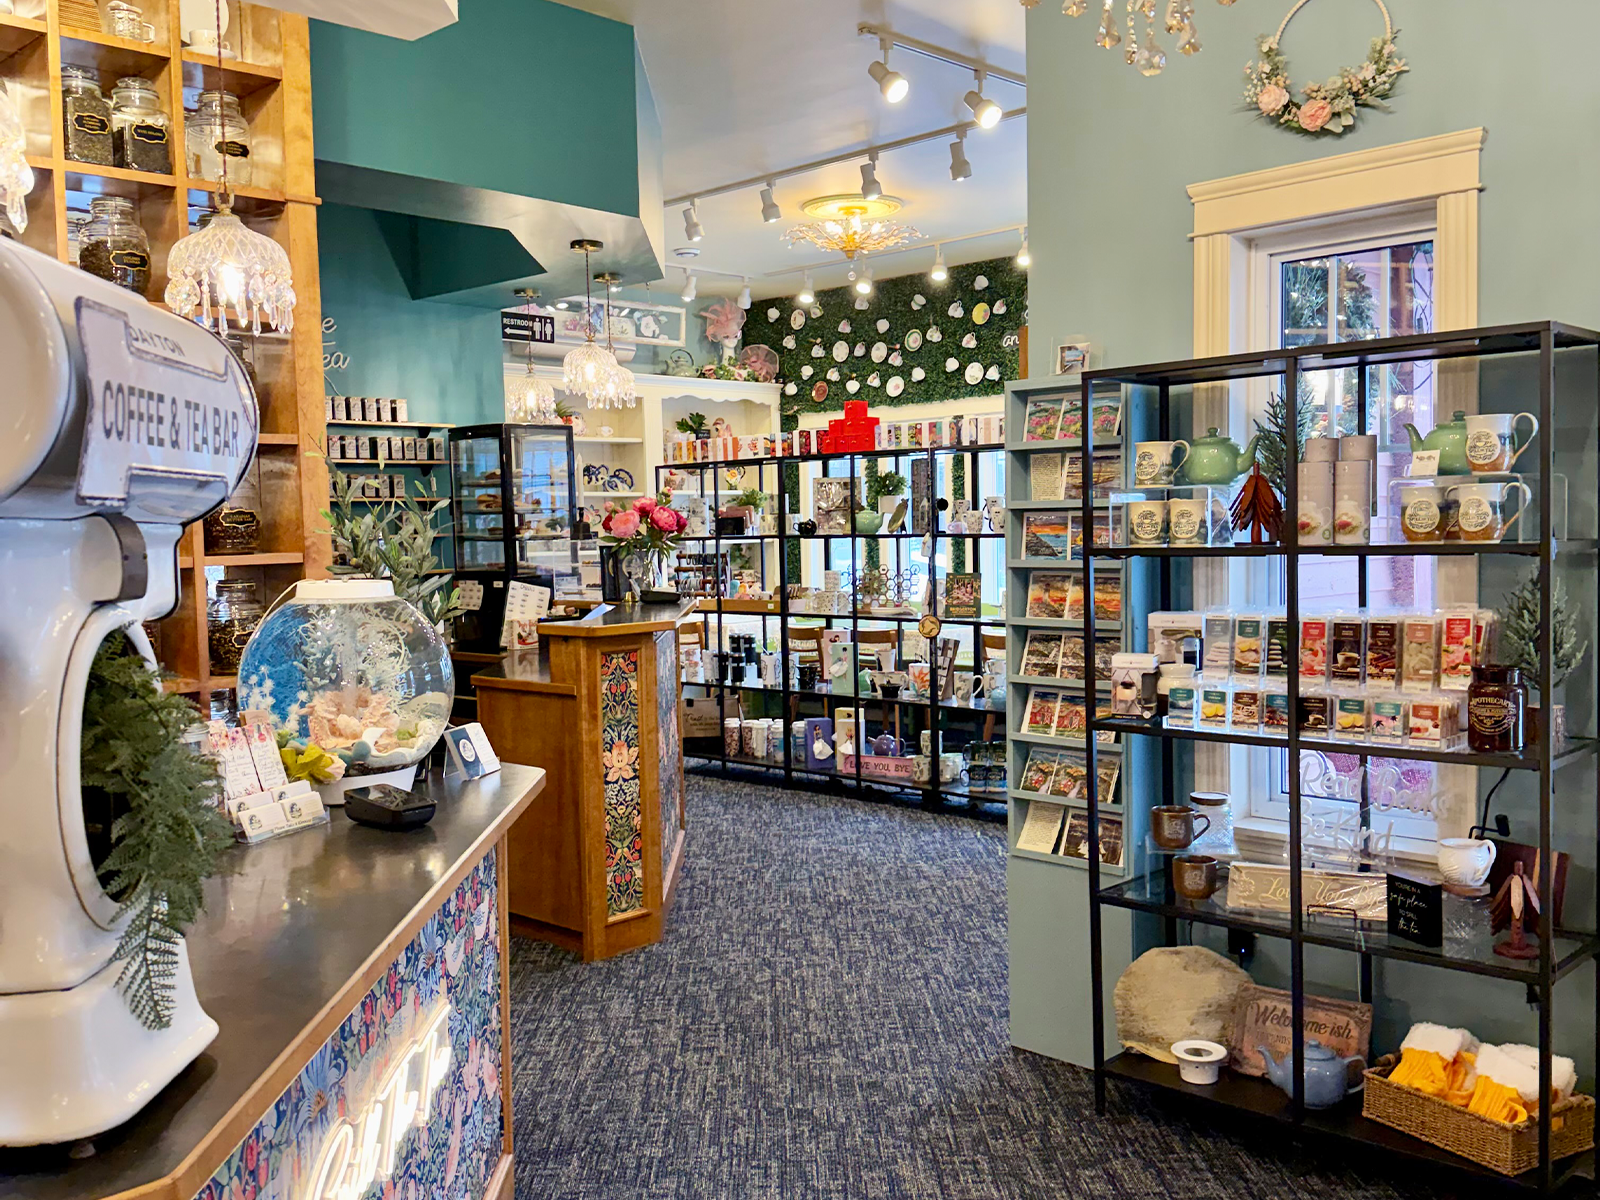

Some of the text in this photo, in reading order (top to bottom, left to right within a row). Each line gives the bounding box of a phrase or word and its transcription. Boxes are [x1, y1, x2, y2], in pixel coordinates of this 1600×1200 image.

[130, 325, 186, 357] DAYTON
[102, 380, 239, 458] COFFEE & TEA BAR
[850, 760, 910, 773] LVE YOU, BYE
[1300, 751, 1365, 803] Read
[1331, 806, 1395, 856] Kind
[1310, 880, 1344, 904] You
